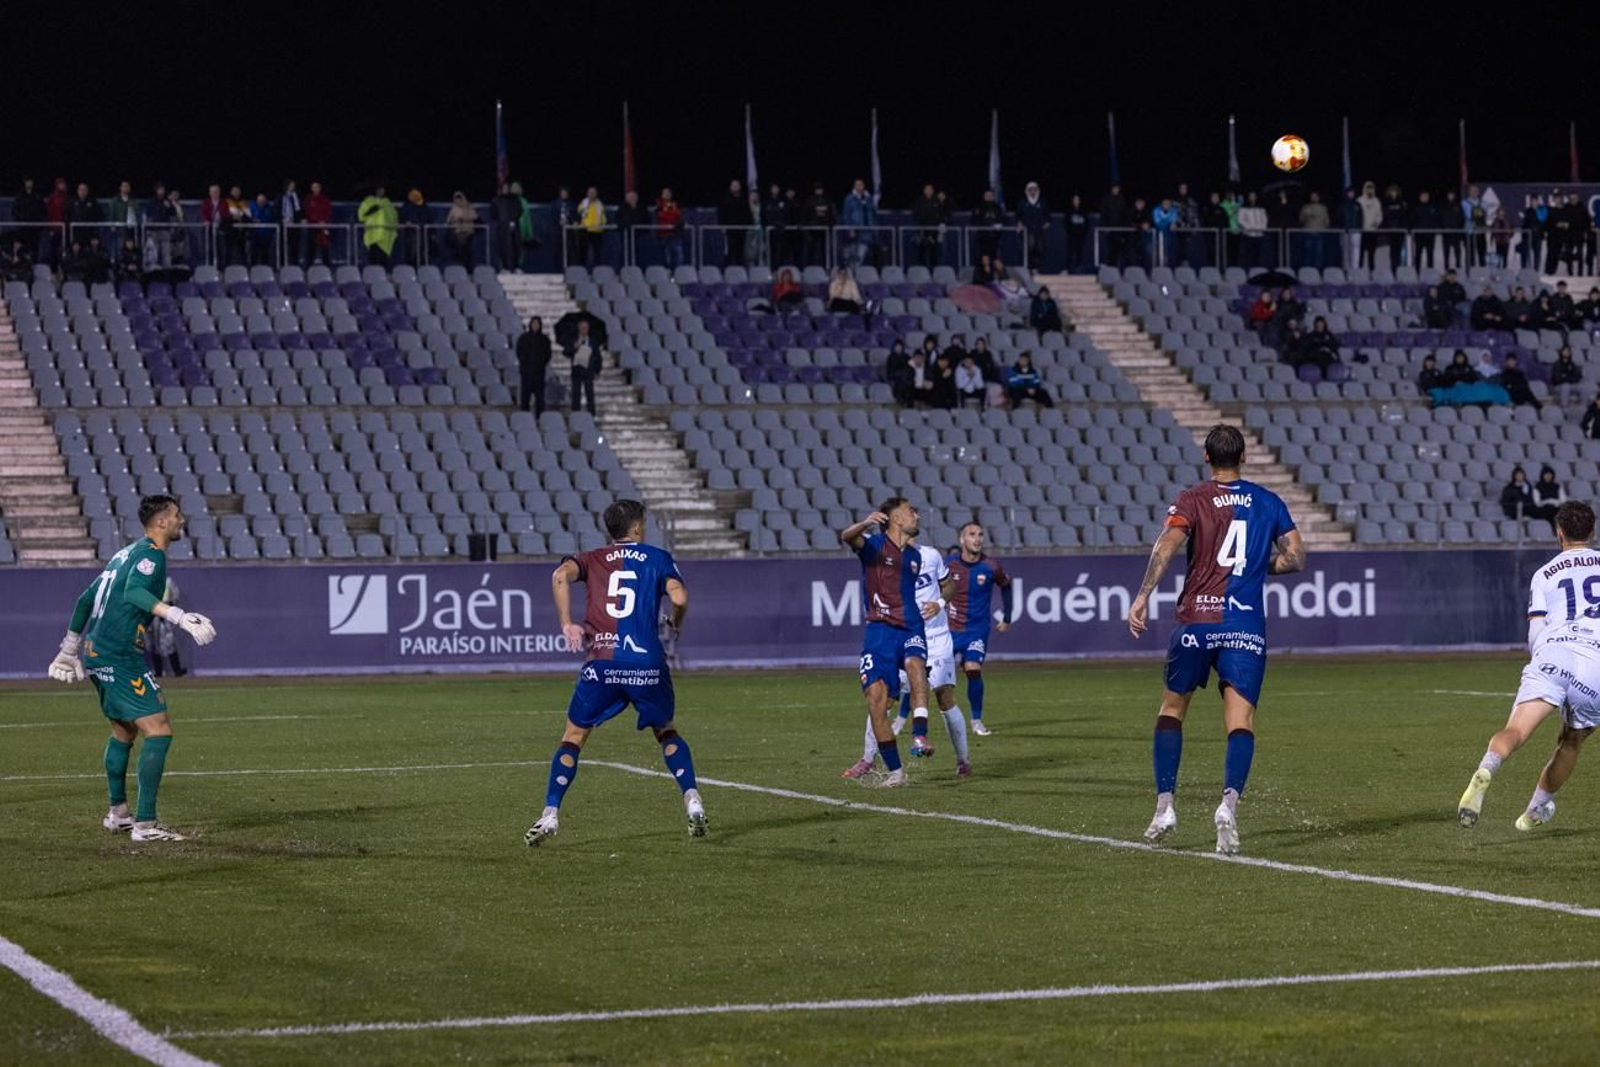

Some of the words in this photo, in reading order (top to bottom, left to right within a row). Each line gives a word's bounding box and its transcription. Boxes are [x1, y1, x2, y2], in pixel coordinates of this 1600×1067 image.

[606, 549, 647, 562] GAIXAS
[1217, 519, 1247, 577] 4
[1543, 559, 1573, 580] AGUS
[398, 573, 532, 633] Jaén
[606, 570, 637, 618] 5
[993, 573, 1130, 623] Jaén
[1150, 568, 1376, 620] Hndai
[1196, 594, 1225, 604] ELDA
[1558, 575, 1600, 621] 19
[400, 631, 486, 655] PARAÍSO
[490, 634, 584, 653] INTERIO
[595, 632, 620, 641] ELDA
[859, 654, 873, 673] 23
